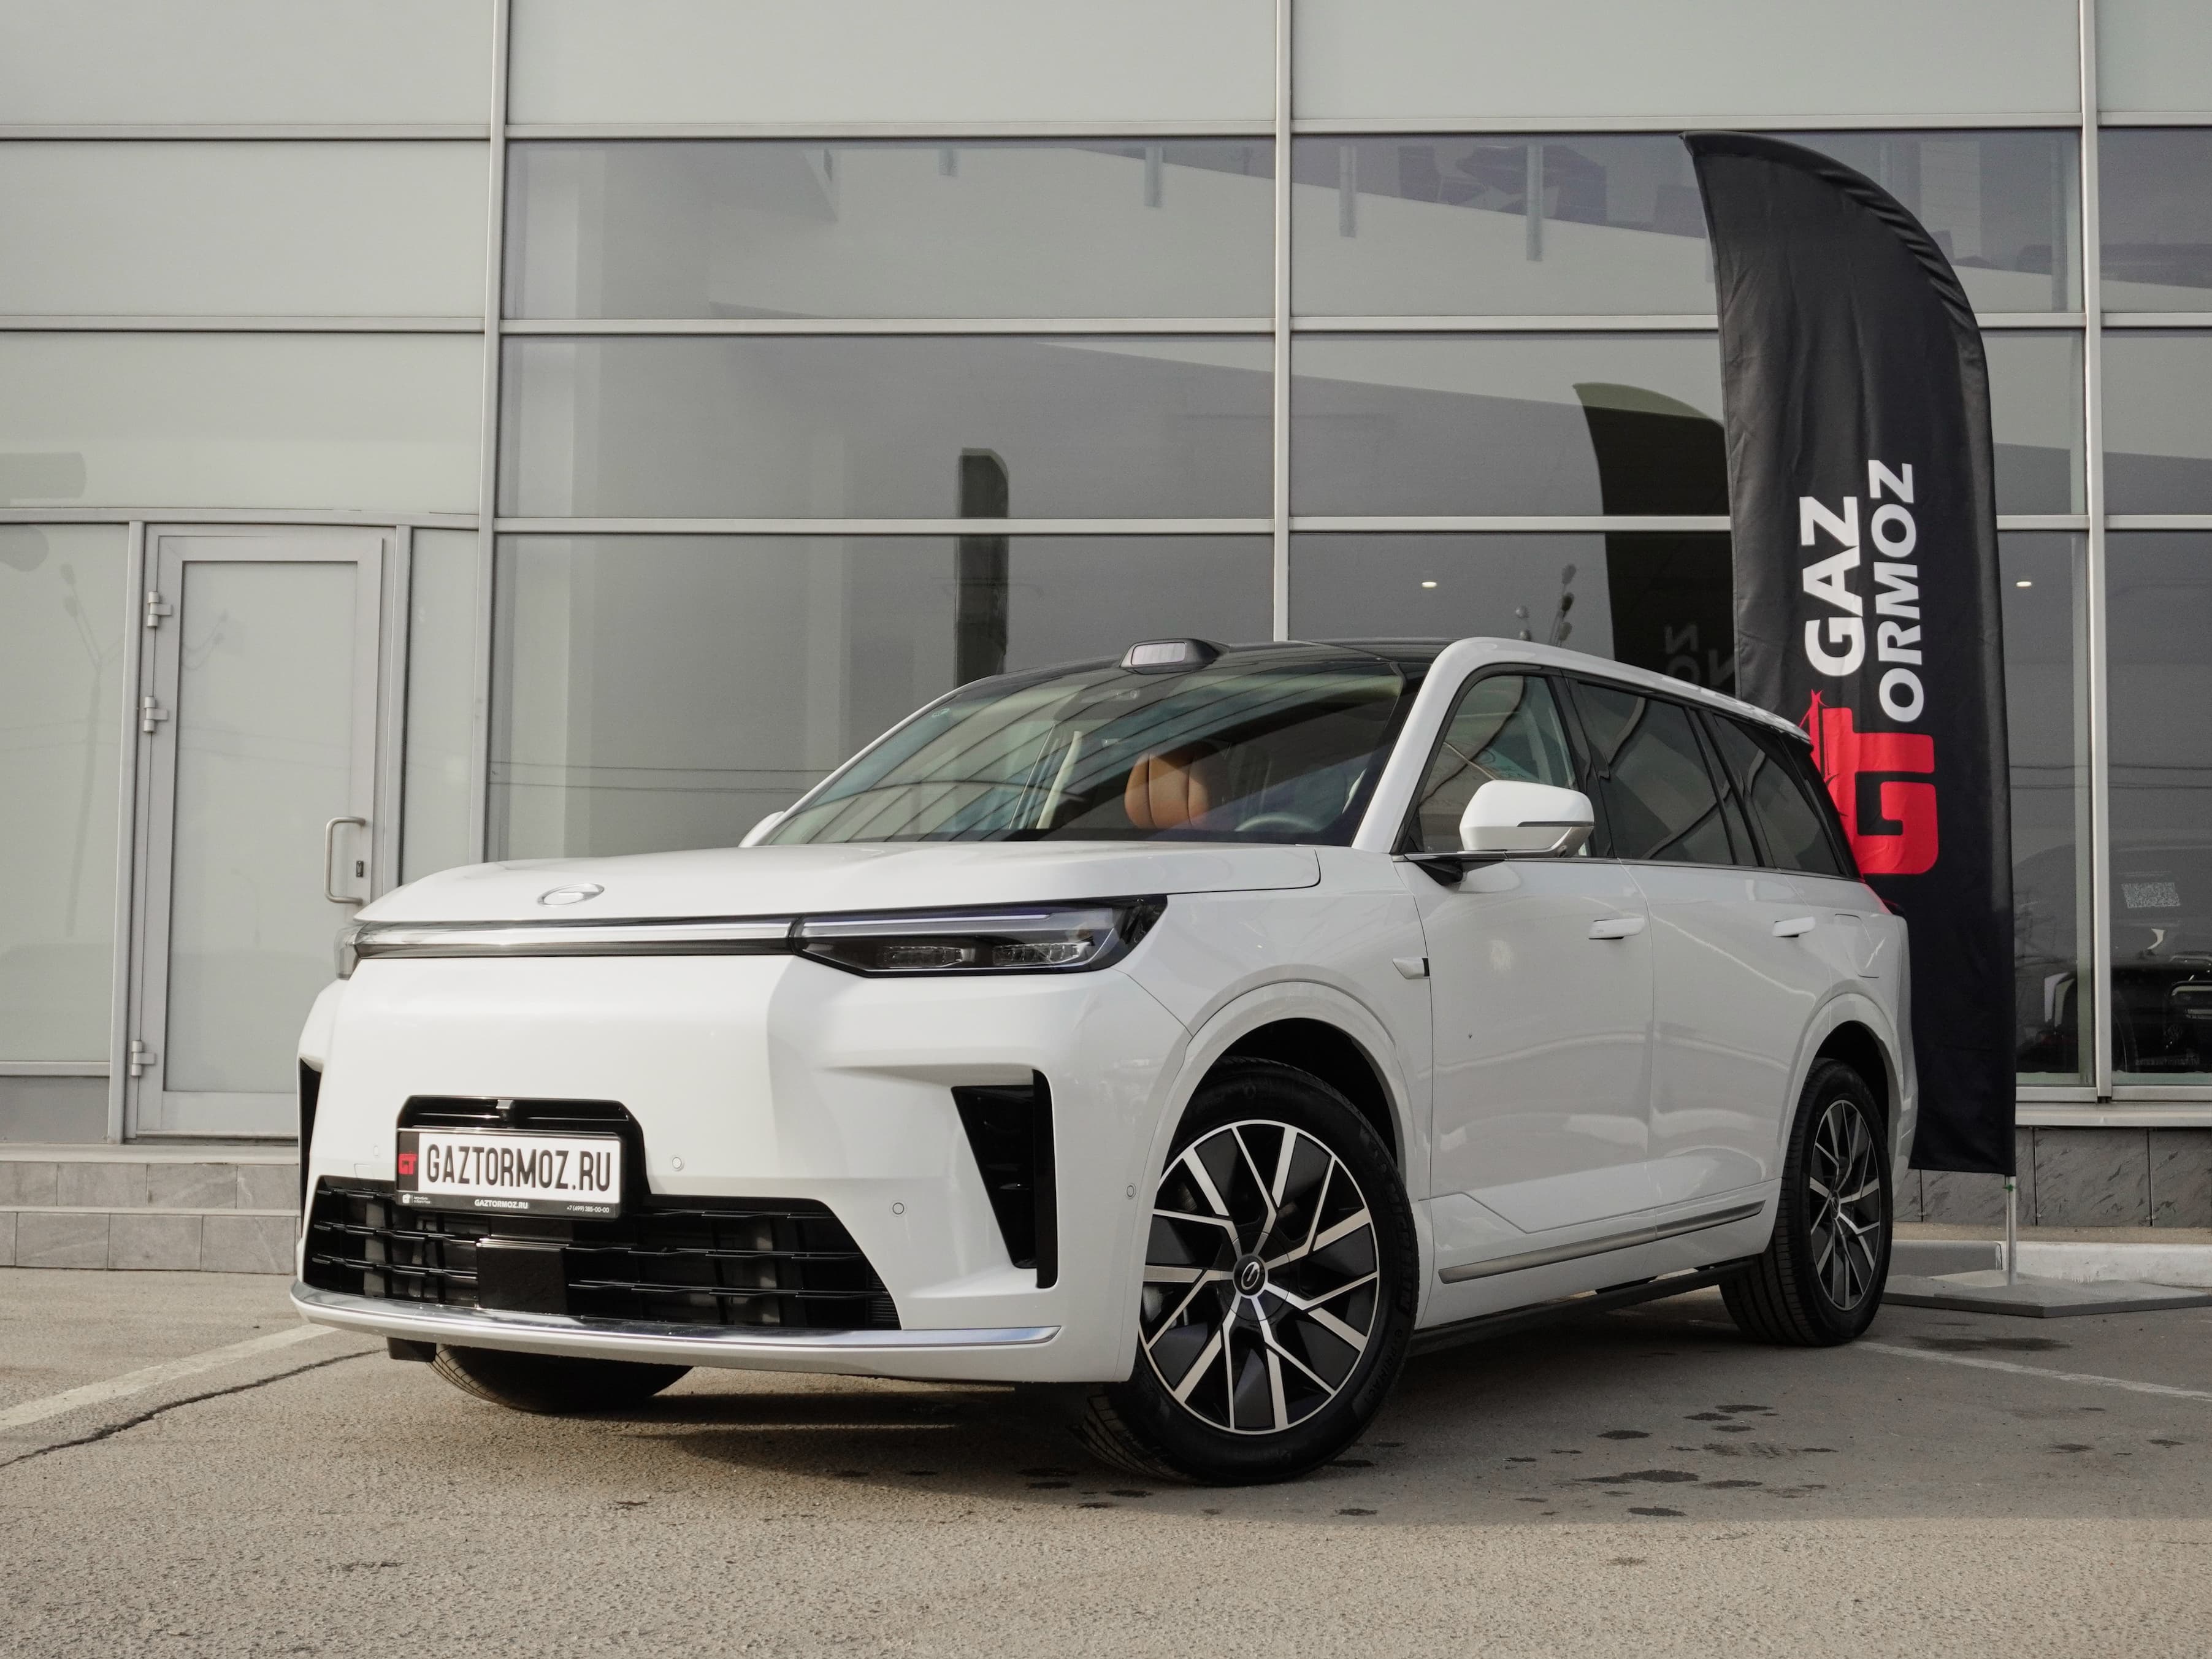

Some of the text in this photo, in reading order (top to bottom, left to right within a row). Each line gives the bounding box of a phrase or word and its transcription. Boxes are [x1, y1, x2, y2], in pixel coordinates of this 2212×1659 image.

[1799, 496, 1866, 676] GAZ
[1868, 459, 1924, 722] ORMOZ
[427, 1144, 611, 1192] GAZTORMOZ.RU
[474, 1198, 529, 1209] GAZTORMOZ.RU
